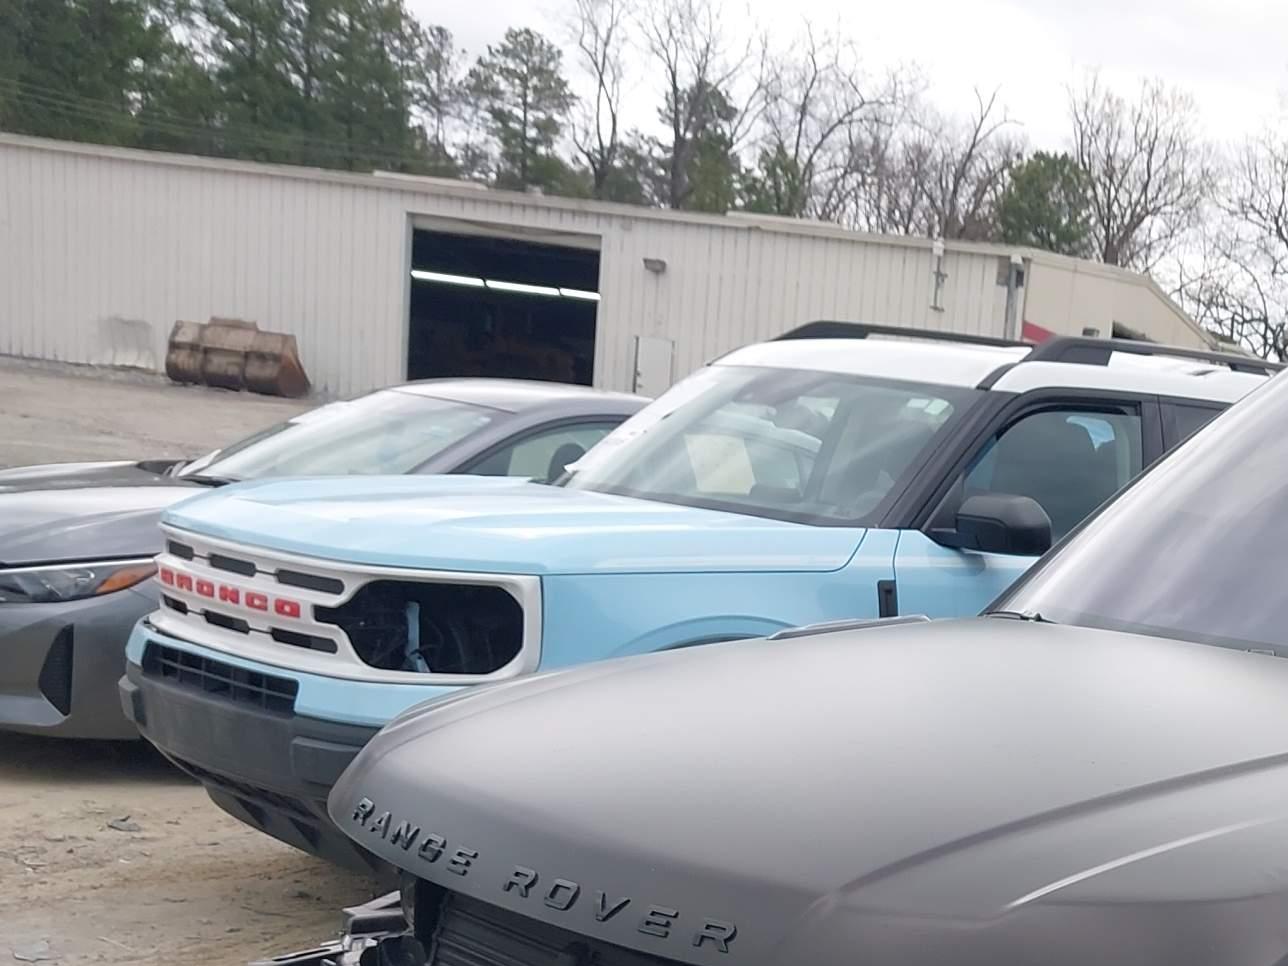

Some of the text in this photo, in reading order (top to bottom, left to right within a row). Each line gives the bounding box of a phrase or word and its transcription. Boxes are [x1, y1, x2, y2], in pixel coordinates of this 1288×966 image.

[161, 568, 300, 618] BRONCO
[351, 797, 737, 953] RANGE ROVER
